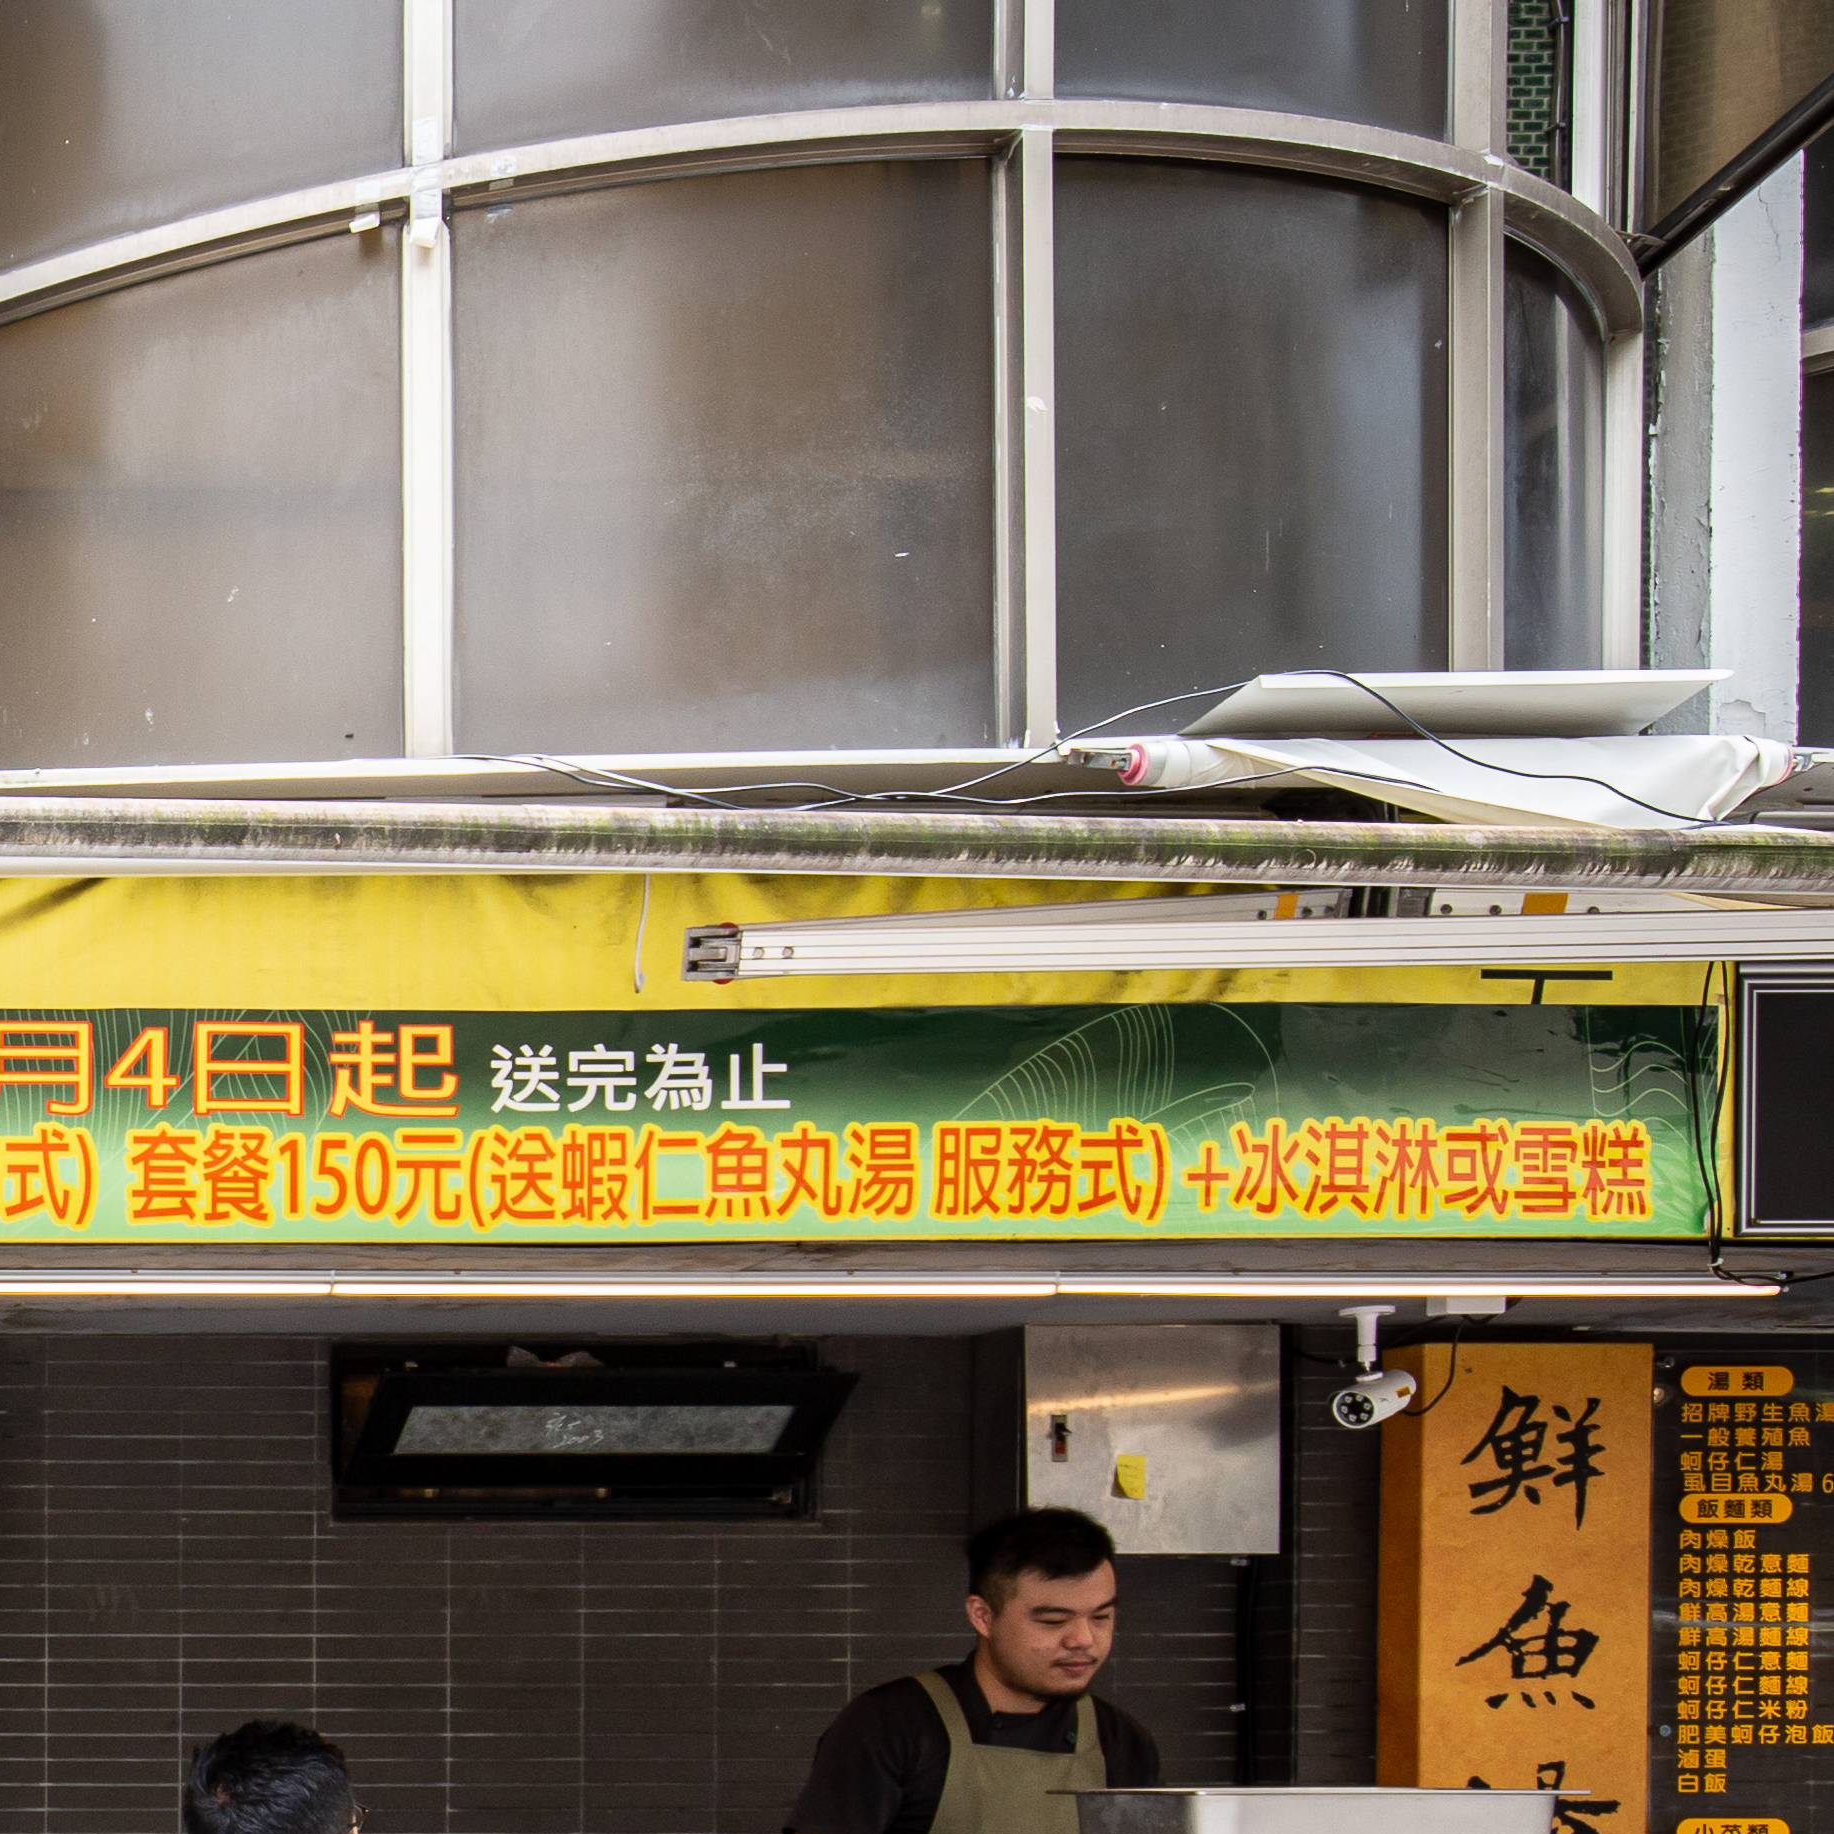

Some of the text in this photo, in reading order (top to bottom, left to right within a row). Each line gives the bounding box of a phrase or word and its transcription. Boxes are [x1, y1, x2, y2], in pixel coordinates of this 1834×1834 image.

[489, 1041, 792, 1113] 送完為止
[1680, 1427, 1811, 1447] 一般養殖魚
[1677, 1773, 1727, 1793] 白飯
